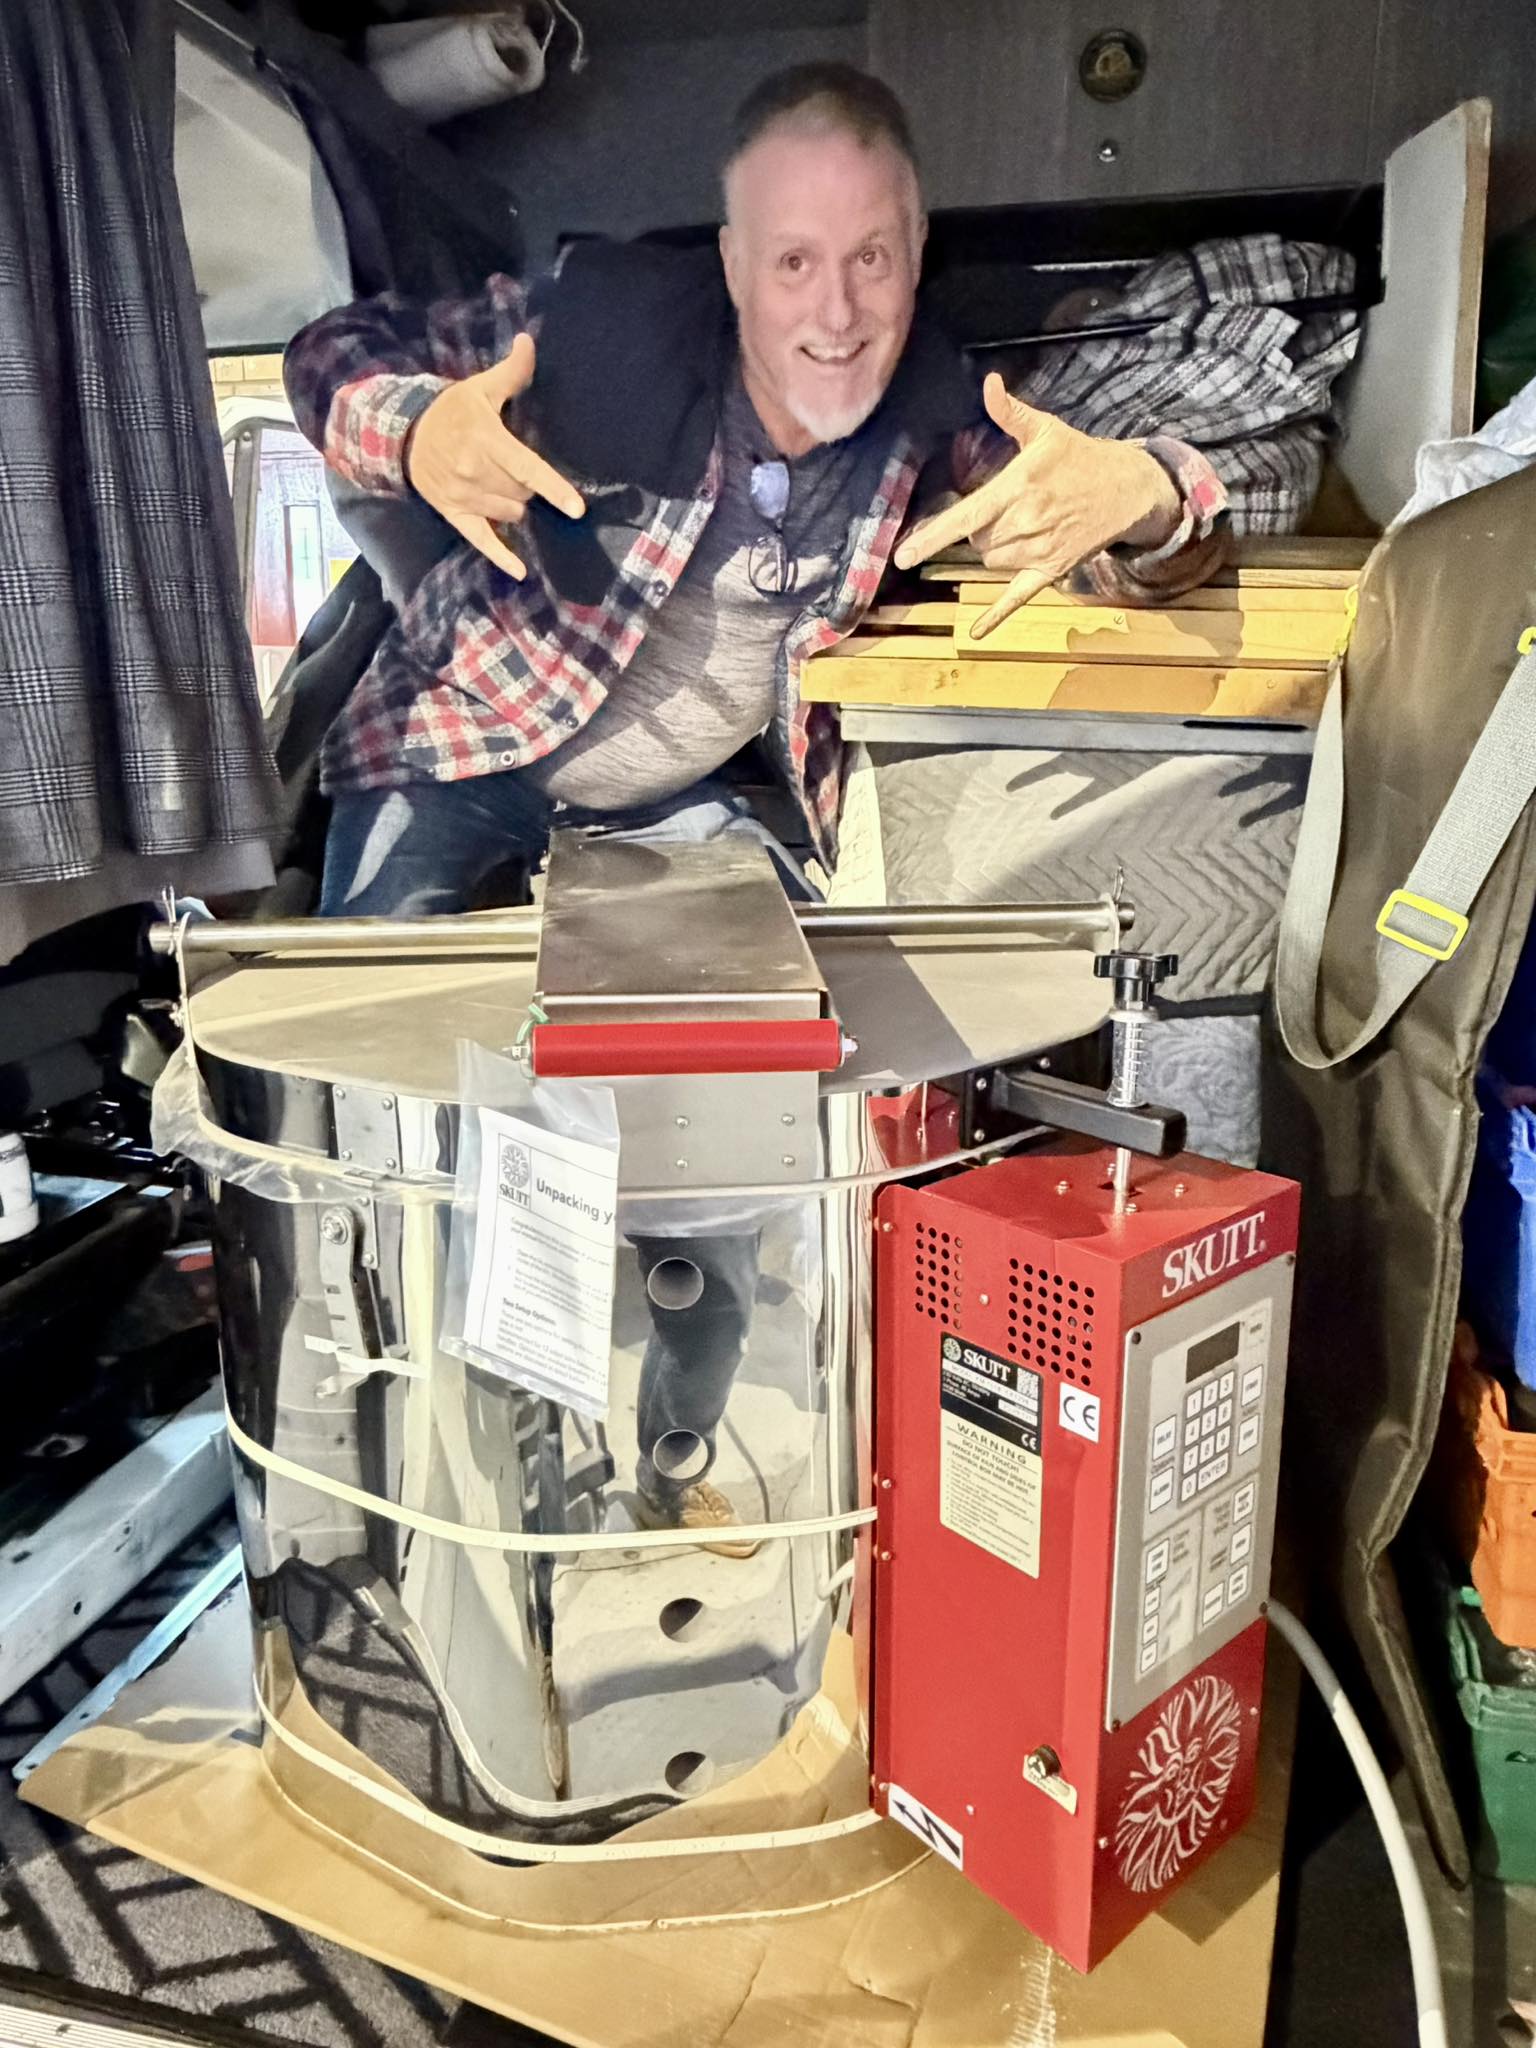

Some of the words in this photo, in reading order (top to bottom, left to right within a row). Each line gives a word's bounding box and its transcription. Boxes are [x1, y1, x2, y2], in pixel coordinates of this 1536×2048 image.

[499, 1183, 530, 1206] SKUTT
[536, 1178, 599, 1221] Unpacking
[1162, 1211, 1266, 1298] SKUTT
[963, 1348, 1011, 1382] SKUTT
[957, 1422, 1027, 1464] WARNING
[1200, 1458, 1226, 1483] ENTER
